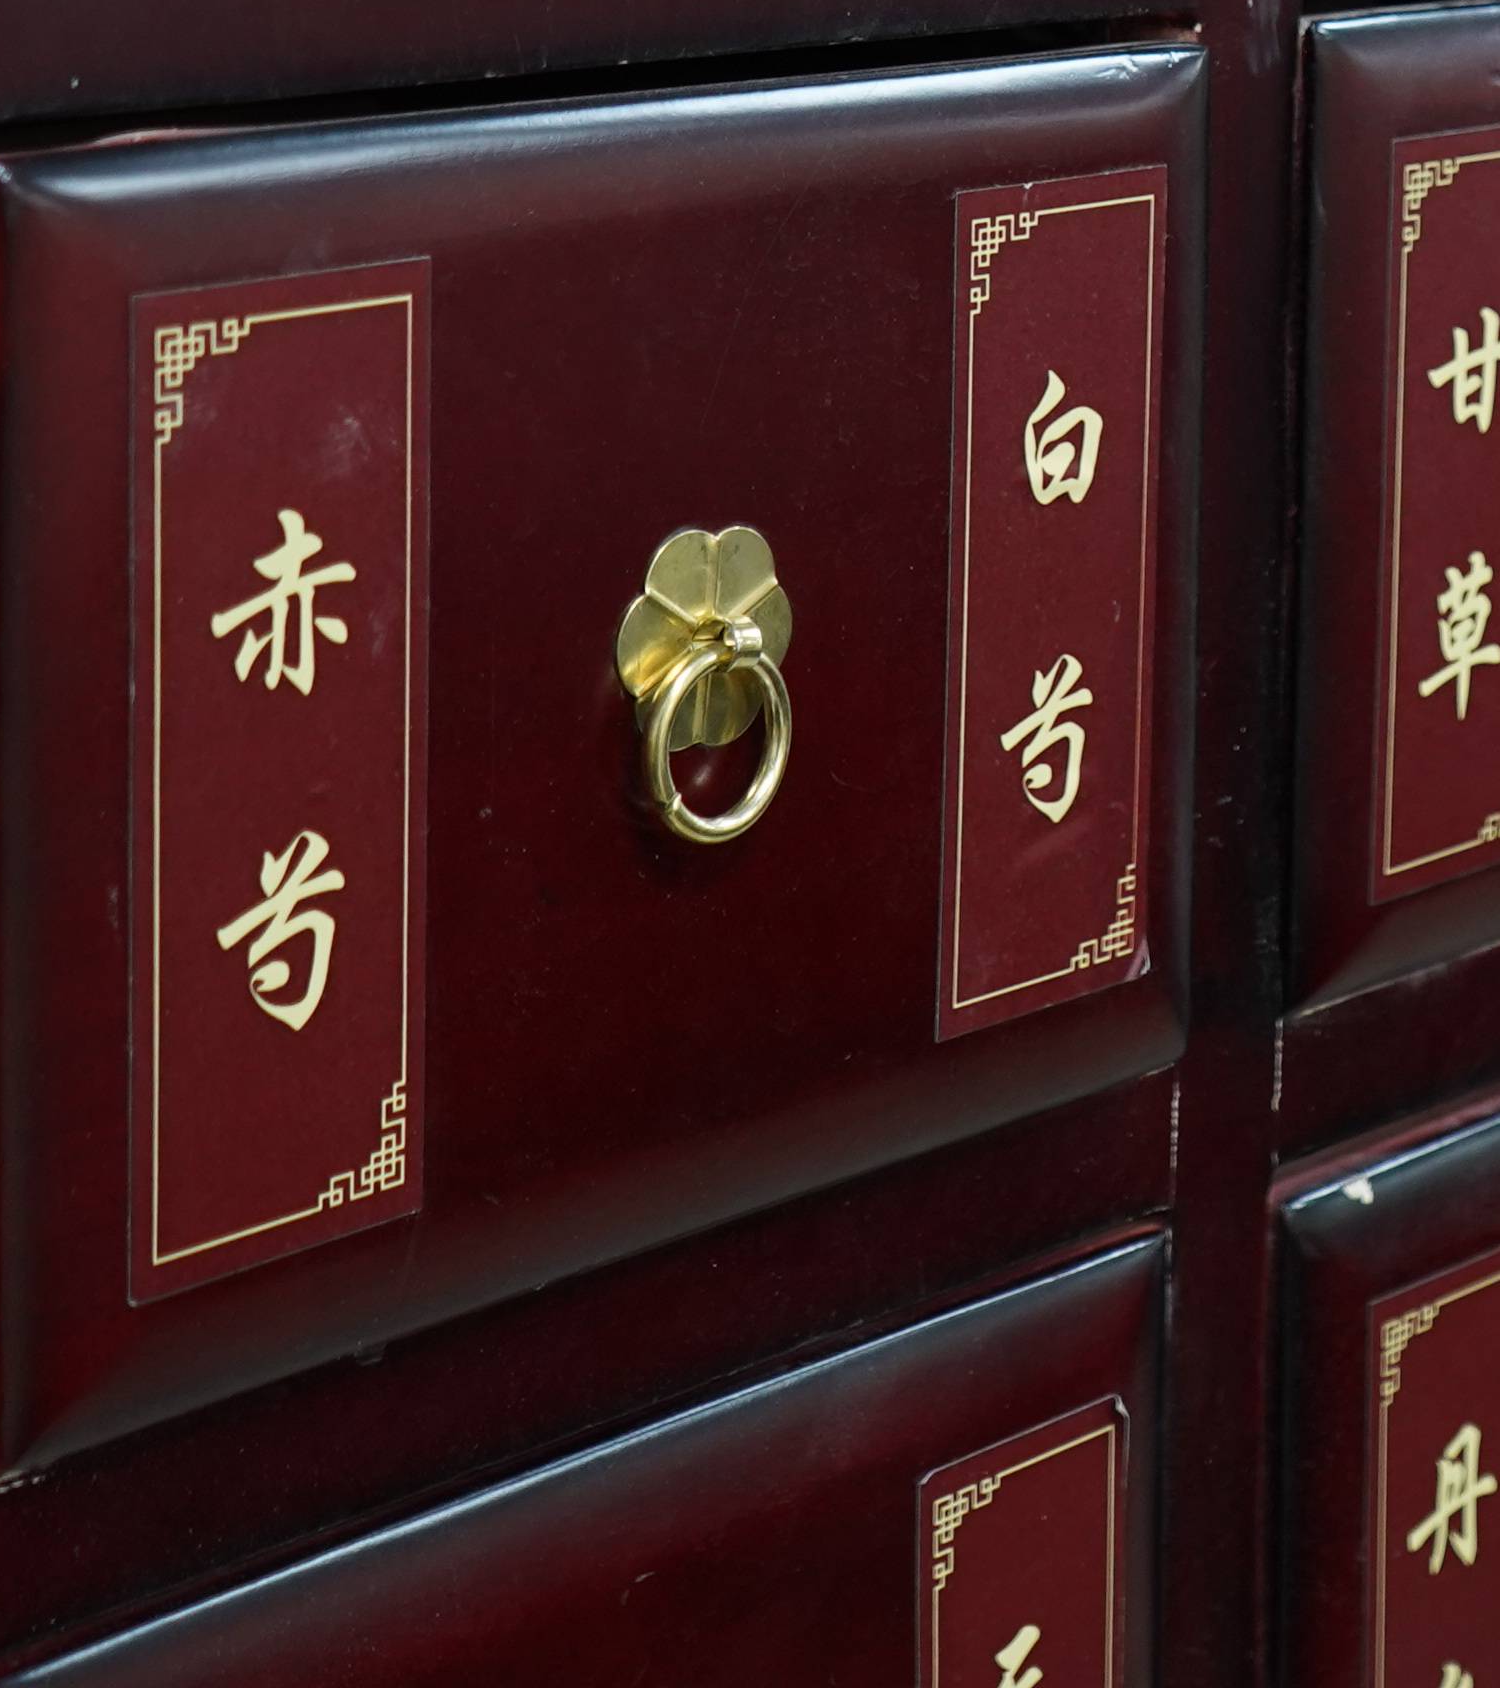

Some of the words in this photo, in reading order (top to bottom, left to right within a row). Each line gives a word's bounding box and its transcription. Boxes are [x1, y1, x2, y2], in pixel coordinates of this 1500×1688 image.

[211, 509, 356, 1030] 赤芍
[1001, 370, 1103, 822] 白芍
[1407, 1424, 1497, 1688] 丹
